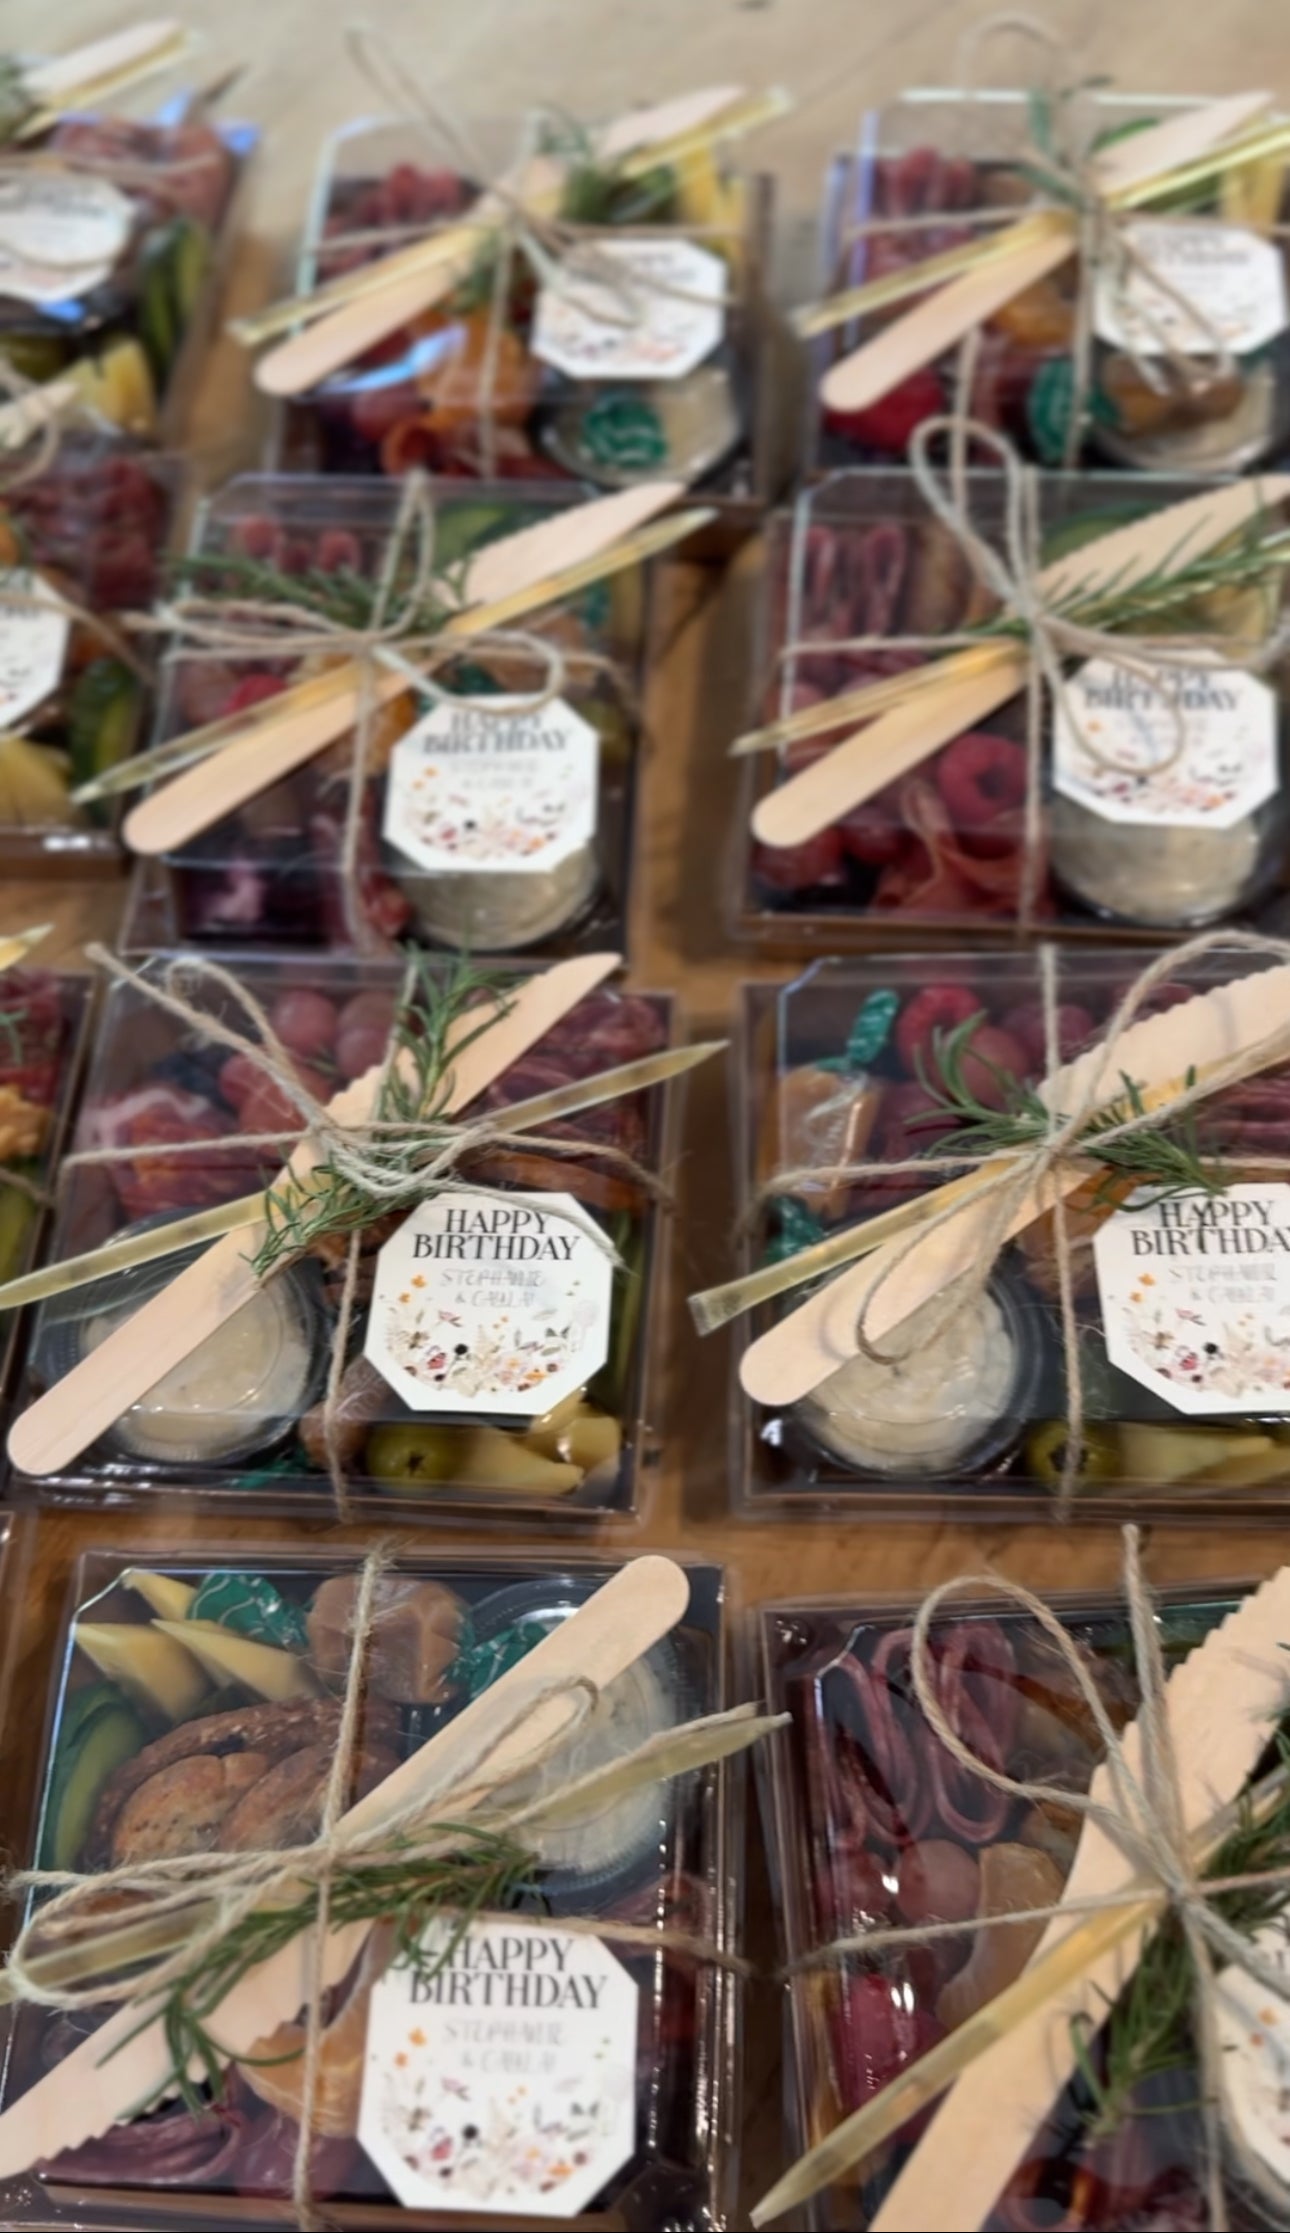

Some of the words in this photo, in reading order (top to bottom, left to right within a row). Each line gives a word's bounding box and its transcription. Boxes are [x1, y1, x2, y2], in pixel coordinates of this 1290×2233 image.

[423, 729, 572, 754] BIRTHDAY
[444, 1208, 548, 1234] HAPPY
[1158, 1200, 1274, 1227] HAPPY
[411, 1233, 581, 1261] BIRTHDAY
[446, 1936, 574, 1971] HAPPY
[408, 1970, 609, 2009] BIRTHDAY
